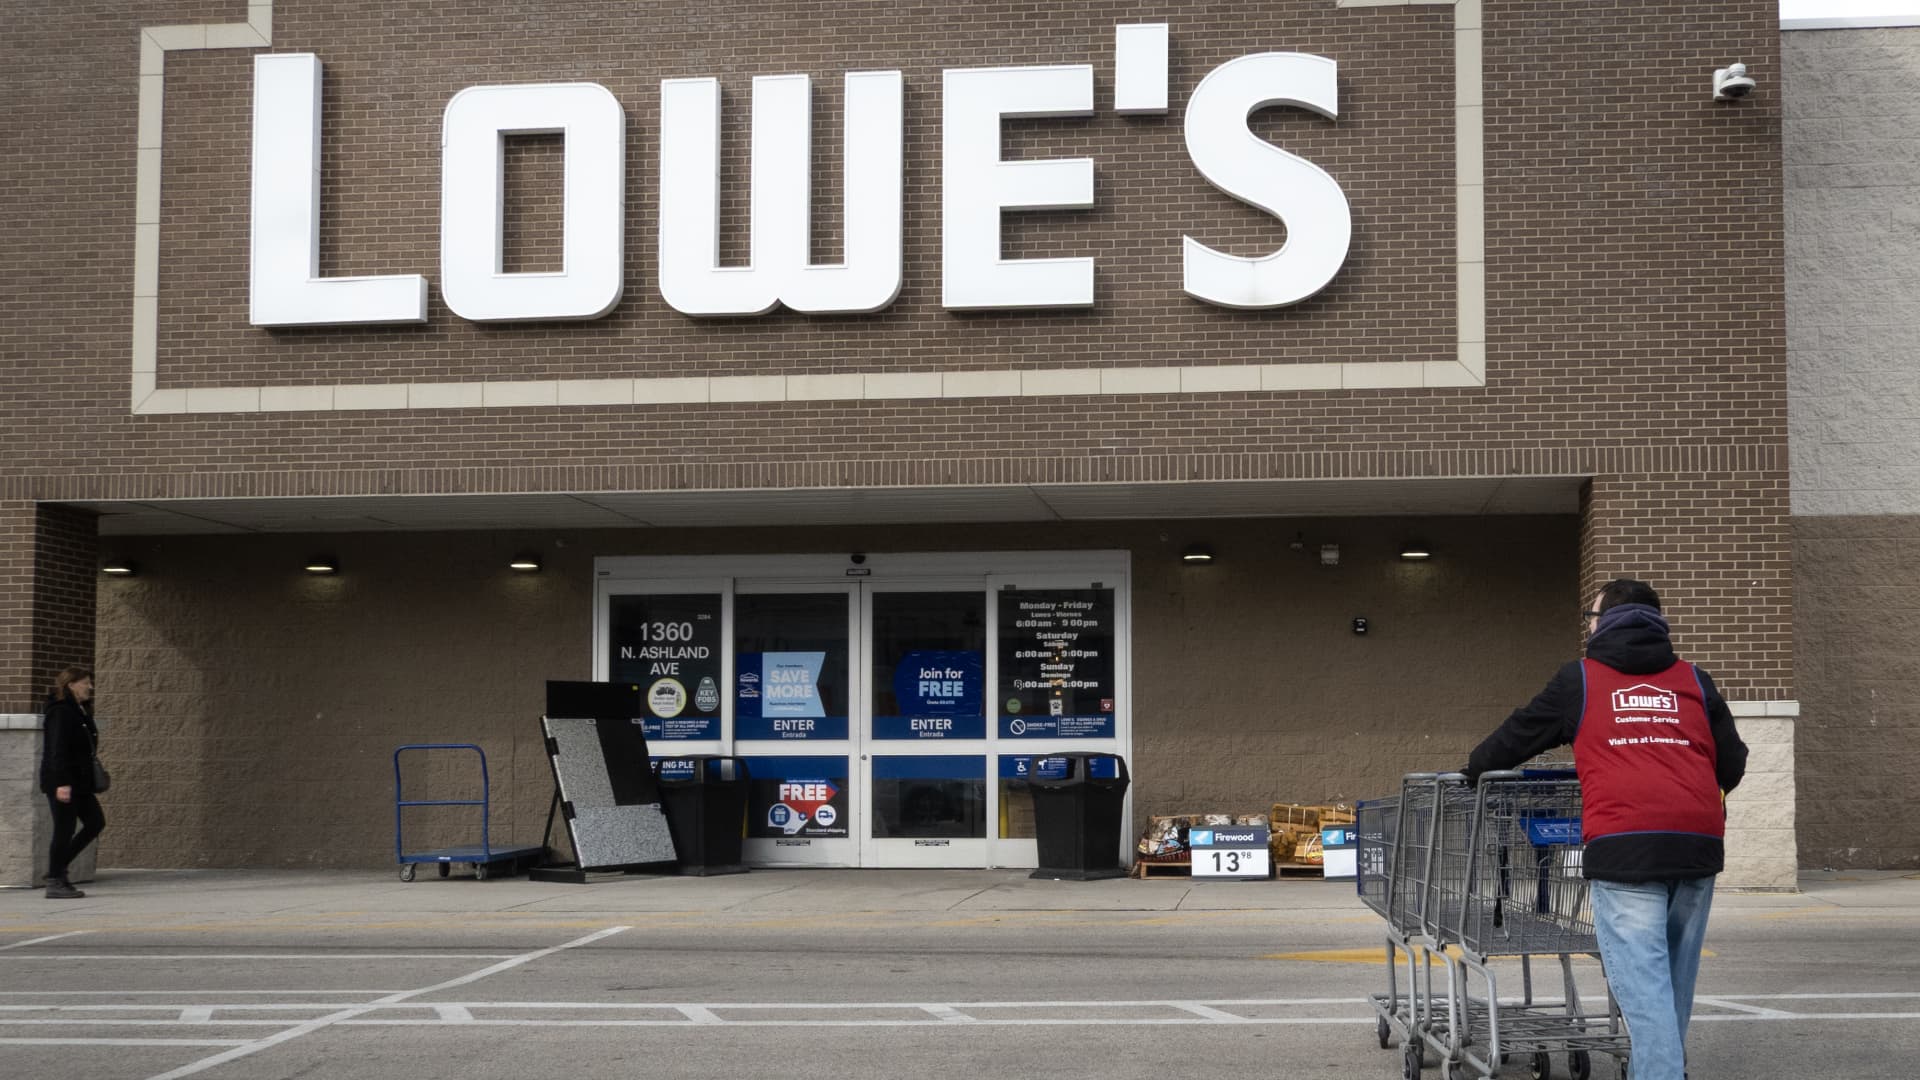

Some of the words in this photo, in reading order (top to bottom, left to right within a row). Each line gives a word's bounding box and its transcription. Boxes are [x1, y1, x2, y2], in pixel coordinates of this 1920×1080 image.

[249, 22, 1352, 326] LOWE'S
[1020, 602, 1056, 610] Monday
[1063, 602, 1093, 610] Friday
[640, 622, 693, 641] 1360
[1036, 632, 1078, 640] Saturday
[621, 646, 636, 659] N.
[639, 646, 709, 659] ASHLAND
[650, 662, 680, 675] AVE
[1040, 663, 1074, 671] Sunday
[771, 670, 809, 683] SAVE
[919, 668, 942, 679] Join
[945, 668, 964, 679] for
[767, 684, 813, 698] MORE
[919, 681, 964, 697] FREE
[1619, 694, 1673, 709] LOWE'S
[773, 720, 814, 731] ENTER
[911, 718, 952, 730] ENTER
[1615, 716, 1650, 724] Customer
[1652, 716, 1680, 724] Service
[1608, 738, 1627, 746] Visit
[678, 761, 695, 769] PLE
[779, 784, 827, 801] FREE
[1215, 832, 1254, 842] Firewood
[1346, 832, 1356, 841] Fir
[1212, 852, 1240, 872] 13
